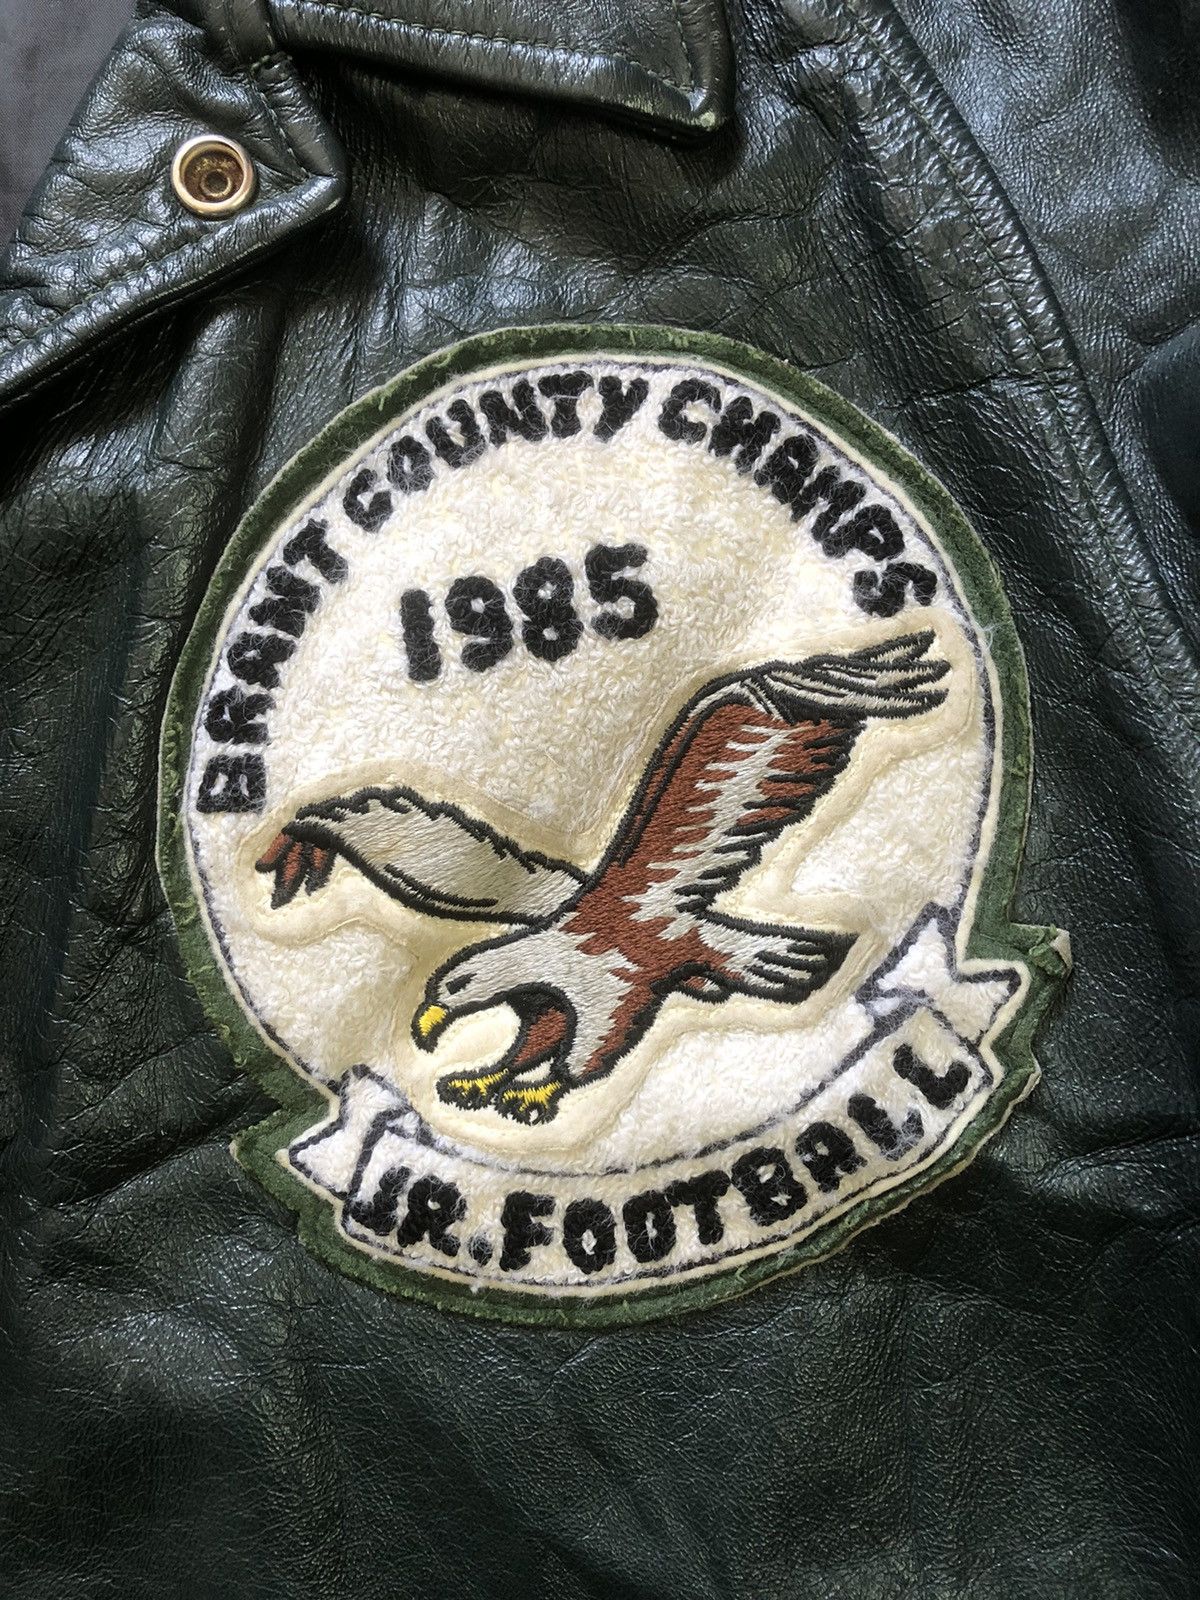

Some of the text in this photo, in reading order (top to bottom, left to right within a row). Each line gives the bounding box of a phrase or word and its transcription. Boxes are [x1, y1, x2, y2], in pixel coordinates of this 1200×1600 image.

[196, 370, 938, 814] BRANT COUNTY CHAMPS
[400, 543, 659, 682] 1985
[499, 1043, 972, 1273] FOOTBALL
